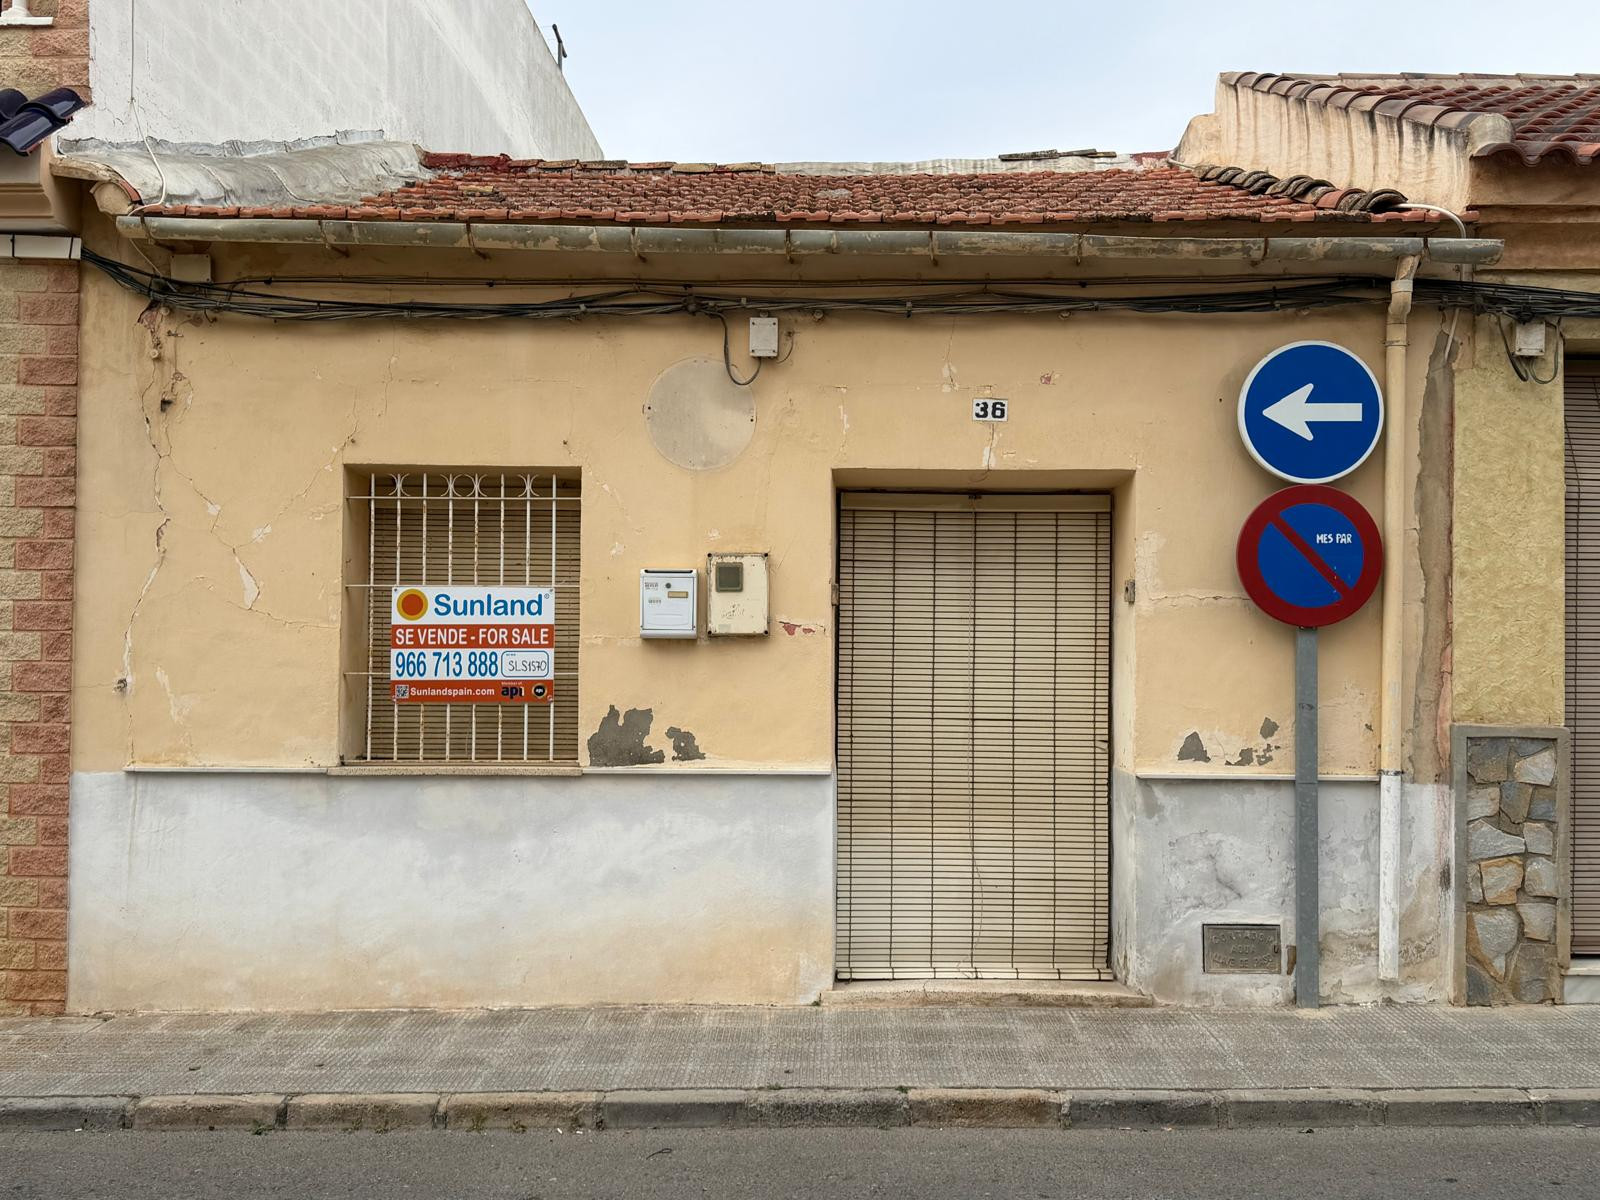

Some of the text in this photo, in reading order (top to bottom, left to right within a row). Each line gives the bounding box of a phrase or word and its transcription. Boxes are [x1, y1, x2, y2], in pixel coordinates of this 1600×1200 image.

[974, 401, 1006, 419] 36
[1316, 533, 1352, 544] MES PAR
[434, 593, 543, 616] Sunland
[395, 628, 414, 645] SE
[417, 628, 468, 645] VENDE
[478, 628, 508, 645] FOR
[511, 628, 549, 645] SALE
[395, 651, 499, 678] 966 713 888
[508, 660, 547, 672] SLS1570
[410, 687, 495, 698] Sunlandspain.com
